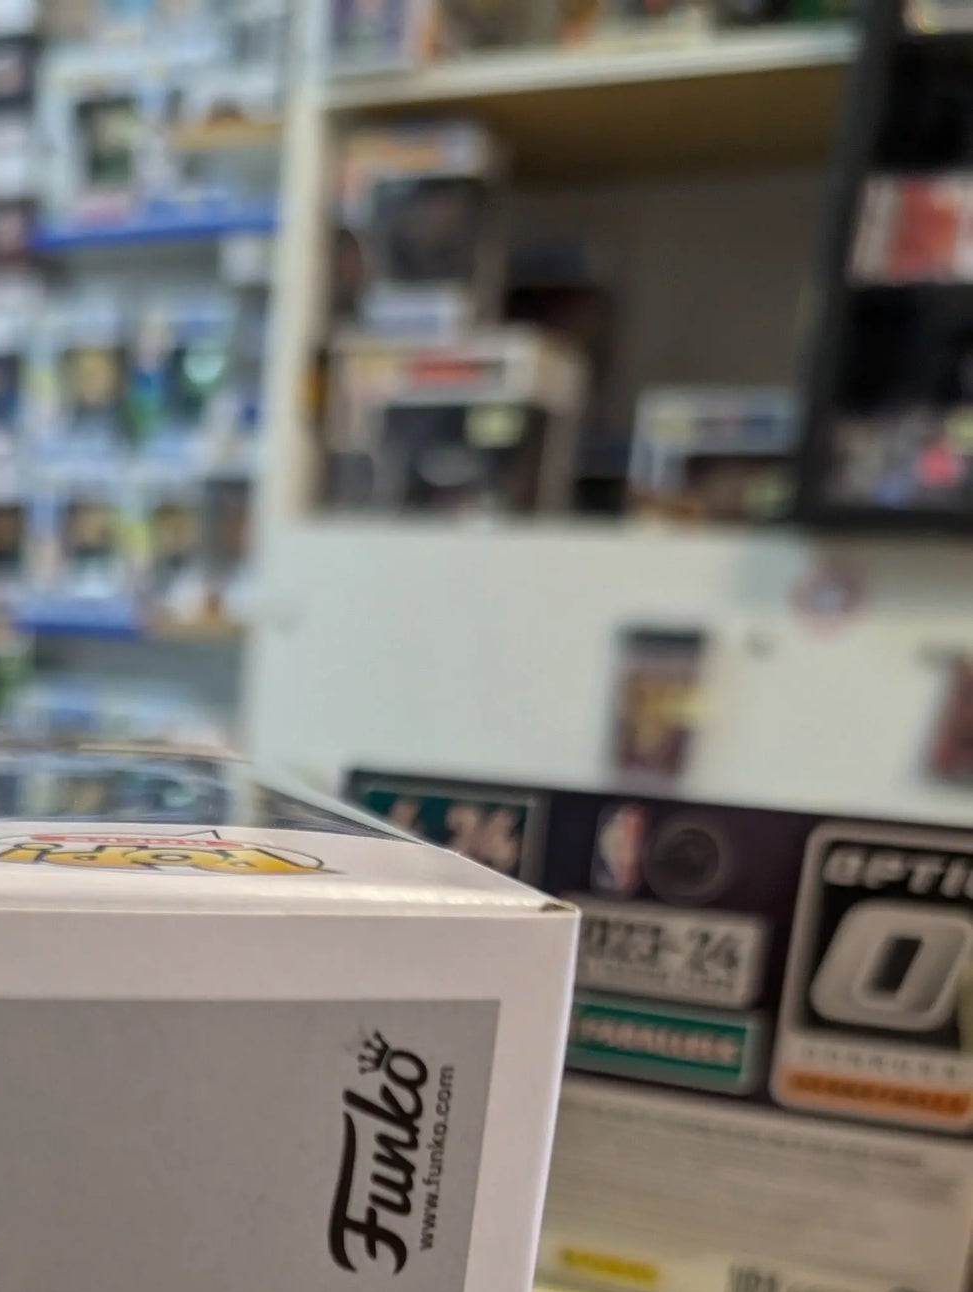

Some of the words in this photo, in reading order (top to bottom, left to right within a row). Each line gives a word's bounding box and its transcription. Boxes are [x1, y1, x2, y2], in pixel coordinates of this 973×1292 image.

[823, 848, 973, 897] OPTI
[330, 1046, 428, 1275] Funko
[420, 1064, 455, 1252] www.funko.com
